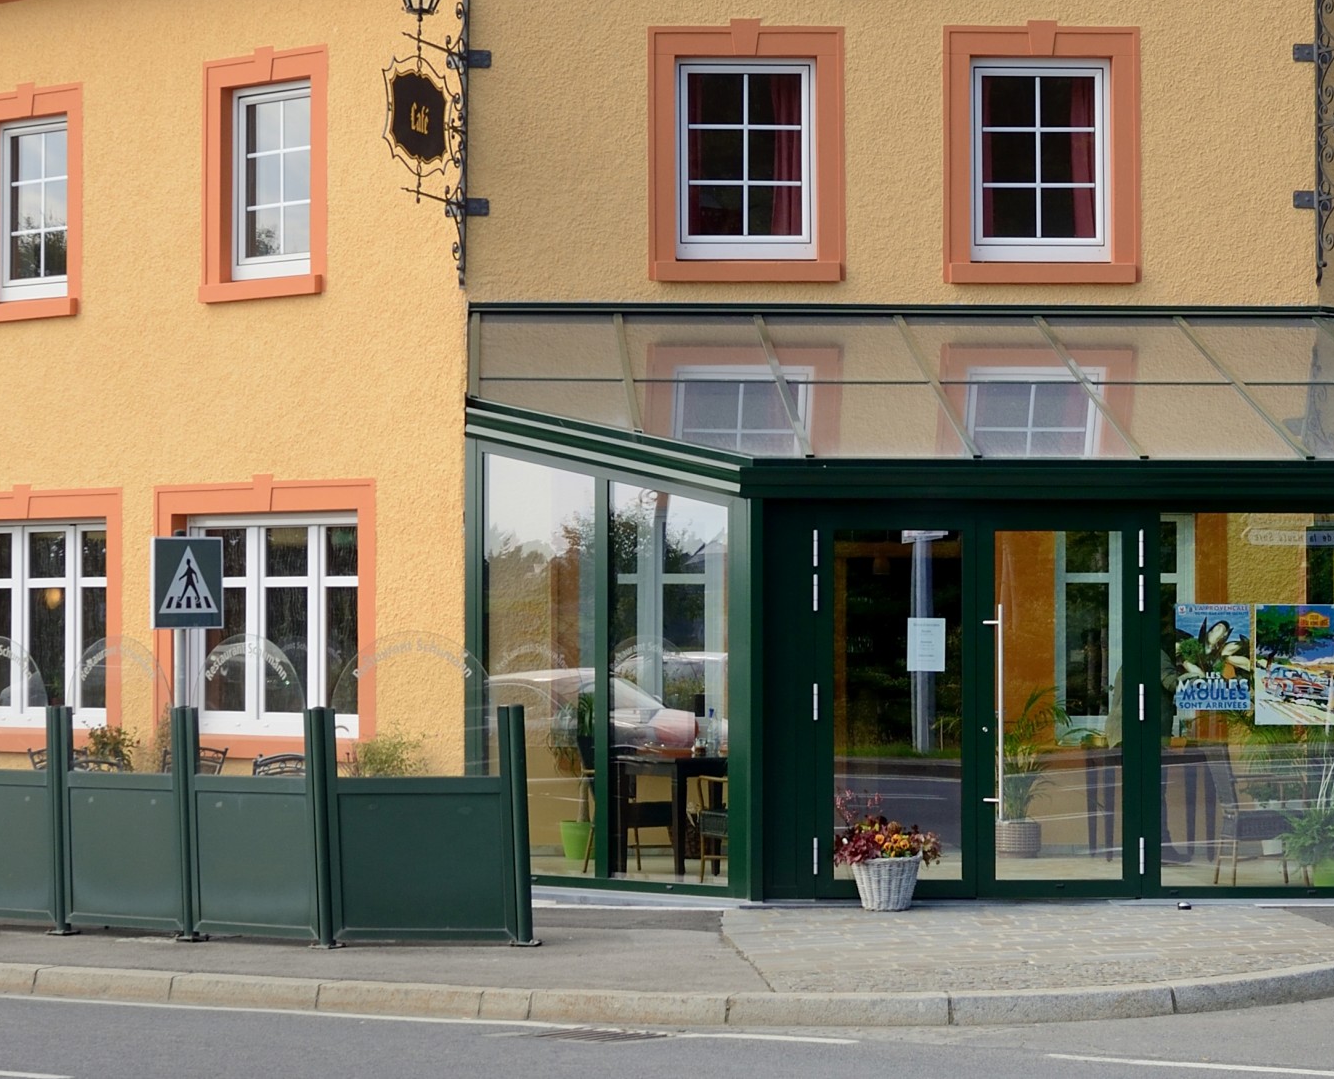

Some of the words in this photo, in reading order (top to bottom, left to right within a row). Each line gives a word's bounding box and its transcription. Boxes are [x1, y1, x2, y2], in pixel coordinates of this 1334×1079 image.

[205, 643, 247, 681] Restaurant
[352, 640, 411, 679] Raurant
[1205, 671, 1221, 679] LES
[1177, 678, 1249, 692] MOULES
[1182, 688, 1247, 701] MOULES
[1205, 700, 1248, 709] ARRIVÉES
